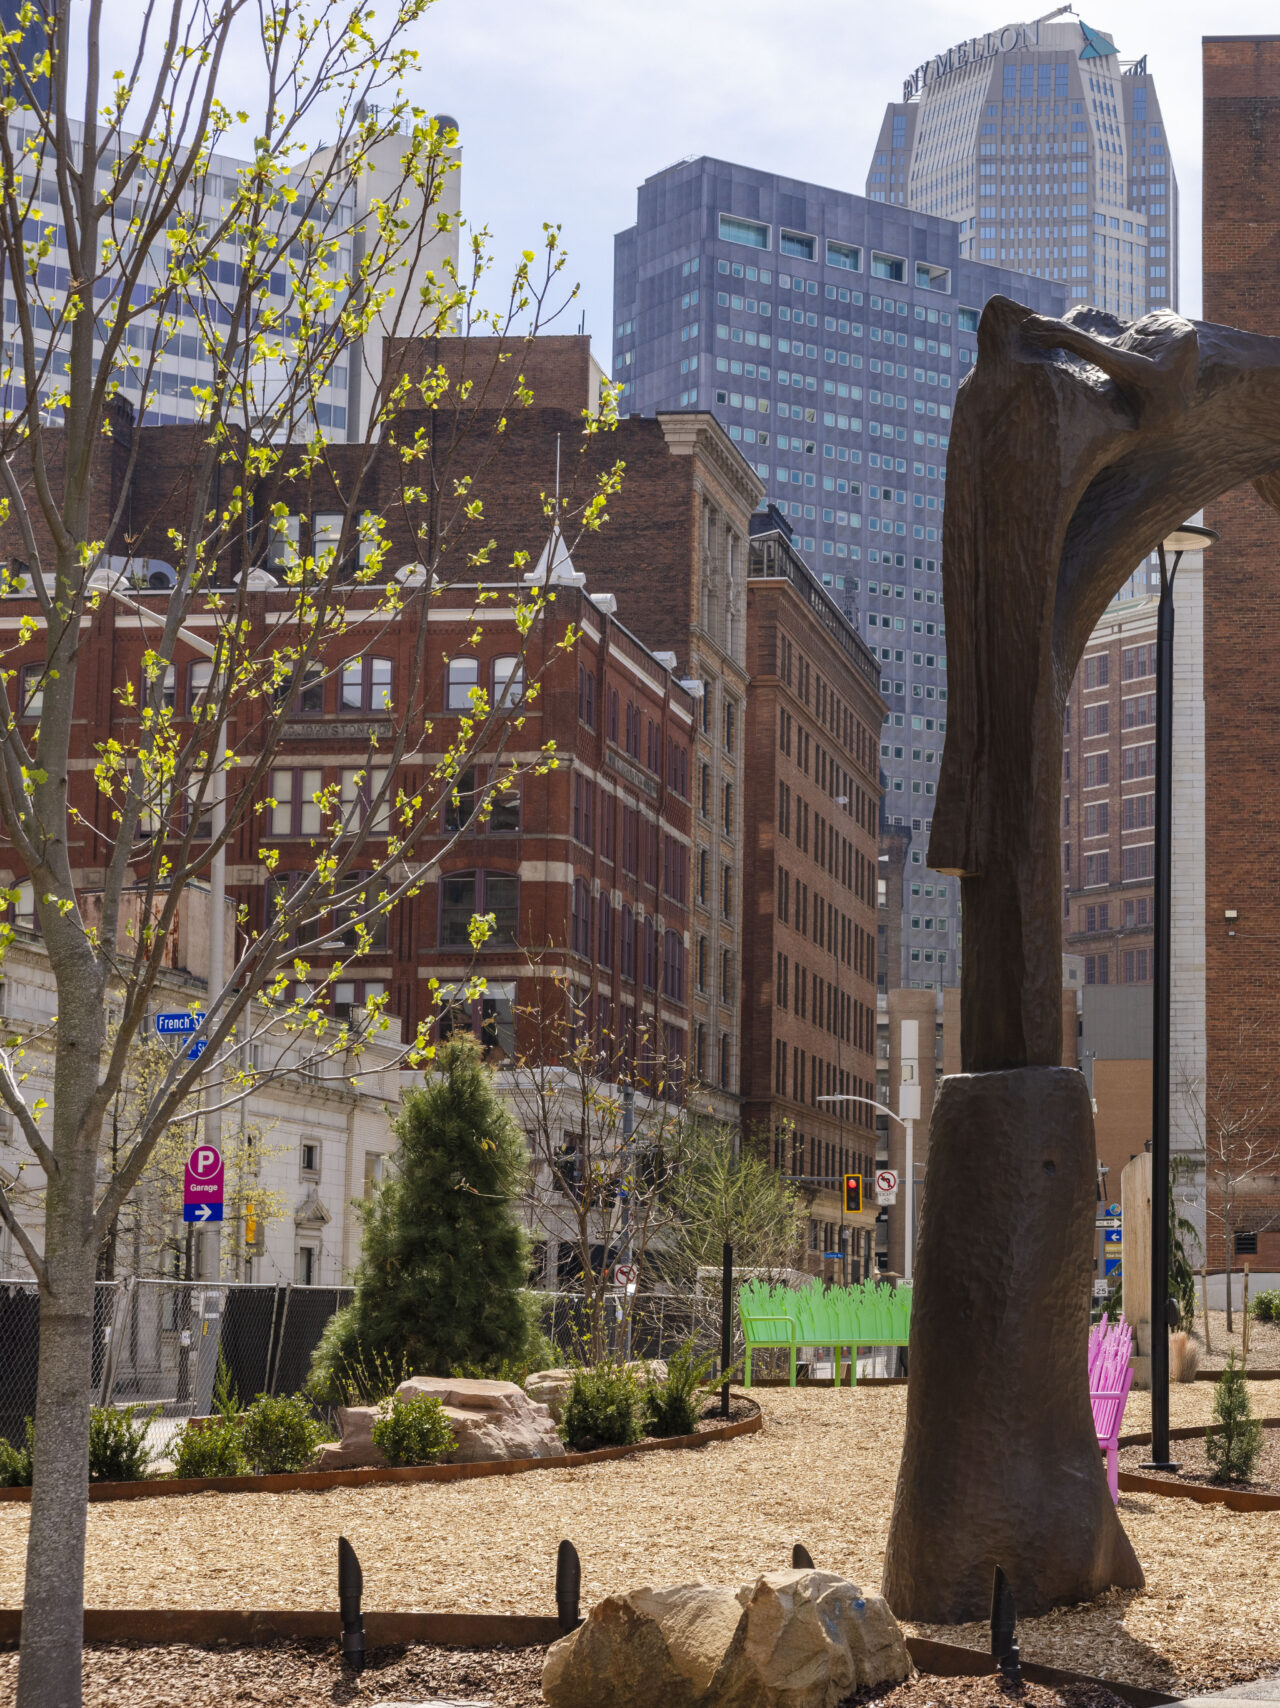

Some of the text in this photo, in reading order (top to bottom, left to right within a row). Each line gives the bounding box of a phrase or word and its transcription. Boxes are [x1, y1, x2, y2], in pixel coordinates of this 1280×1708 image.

[903, 19, 1041, 104] BNY MELLON
[159, 1016, 190, 1030] French
[197, 1150, 215, 1173] P
[190, 1183, 218, 1193] Garage
[1096, 1287, 1107, 1295] 25
